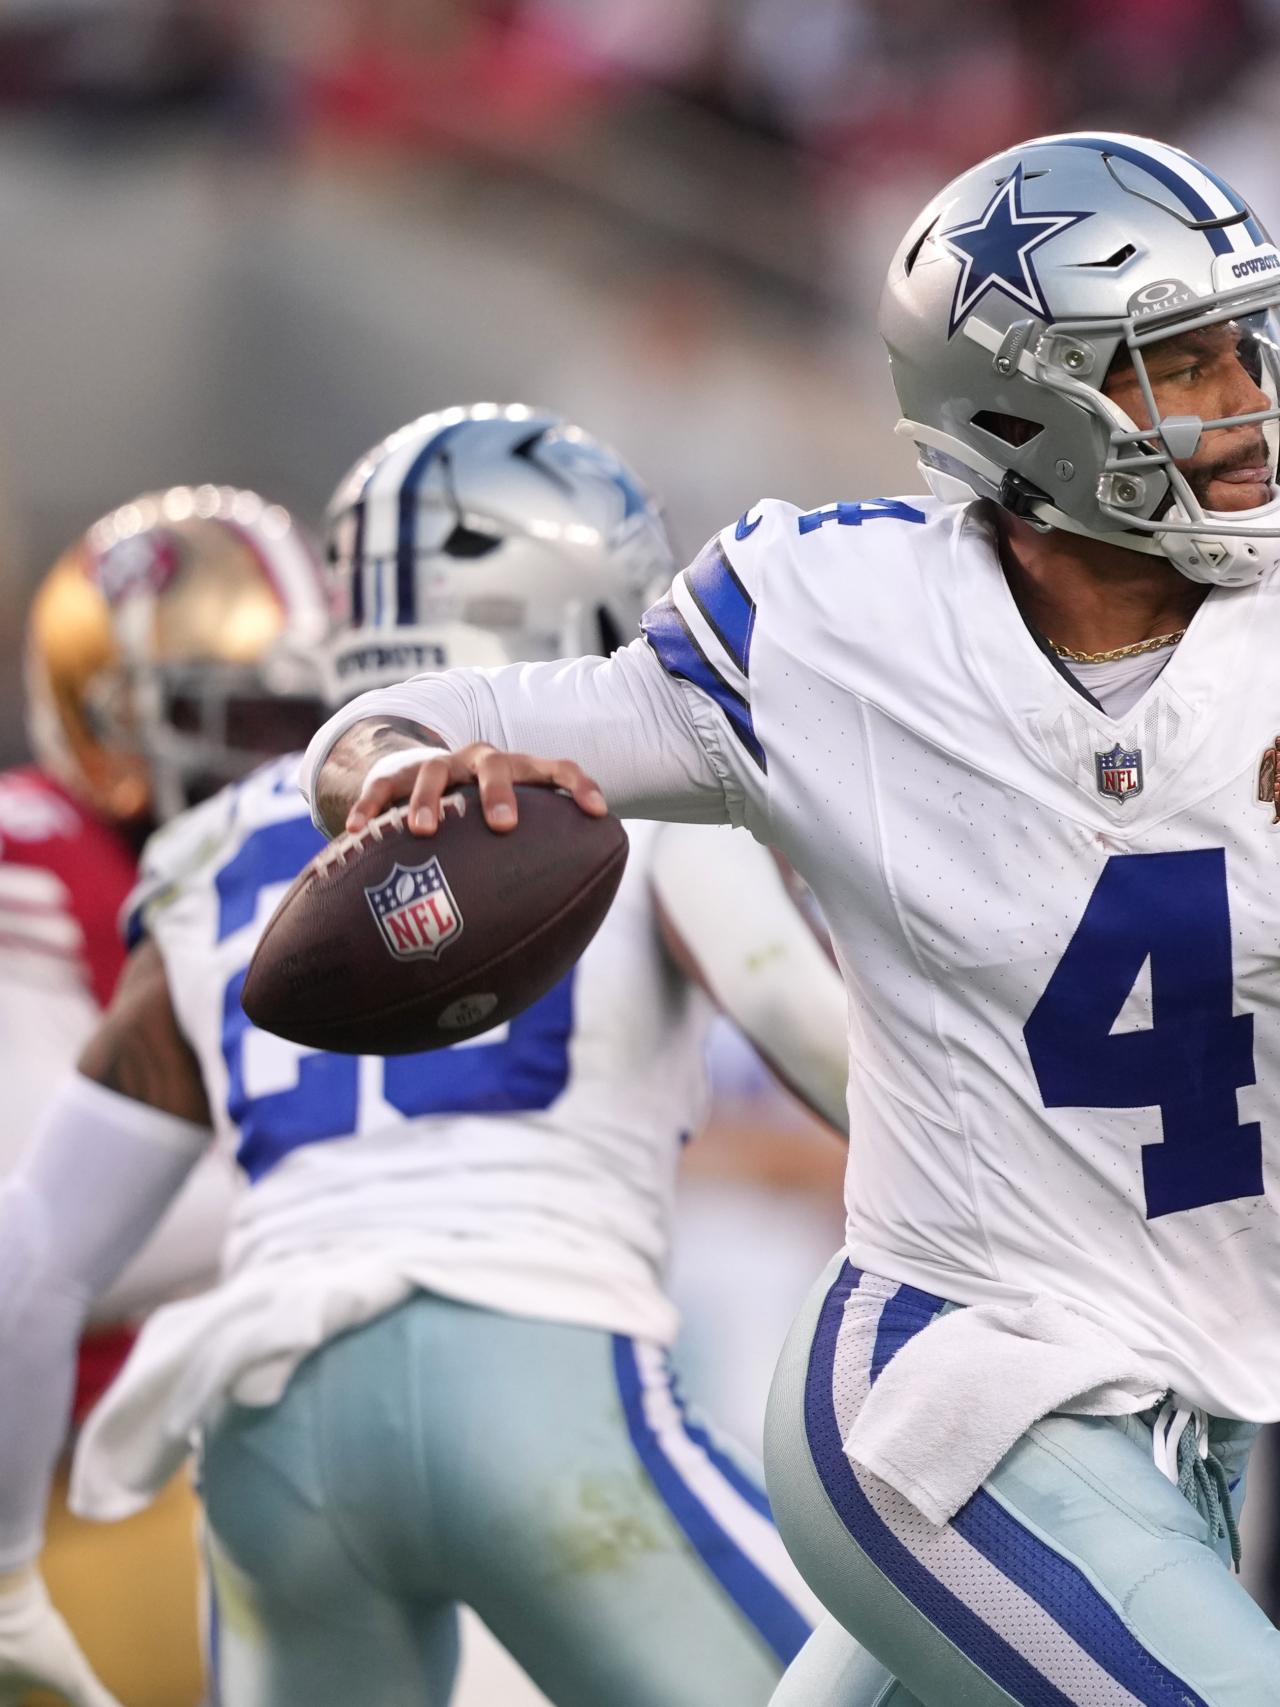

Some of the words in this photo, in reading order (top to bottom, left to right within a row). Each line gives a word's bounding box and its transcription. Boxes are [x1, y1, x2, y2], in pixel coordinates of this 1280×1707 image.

[1231, 254, 1280, 278] COWBOYS
[1103, 769, 1137, 793] NFL
[386, 897, 454, 951] NFL
[1023, 847, 1265, 1220] 4
